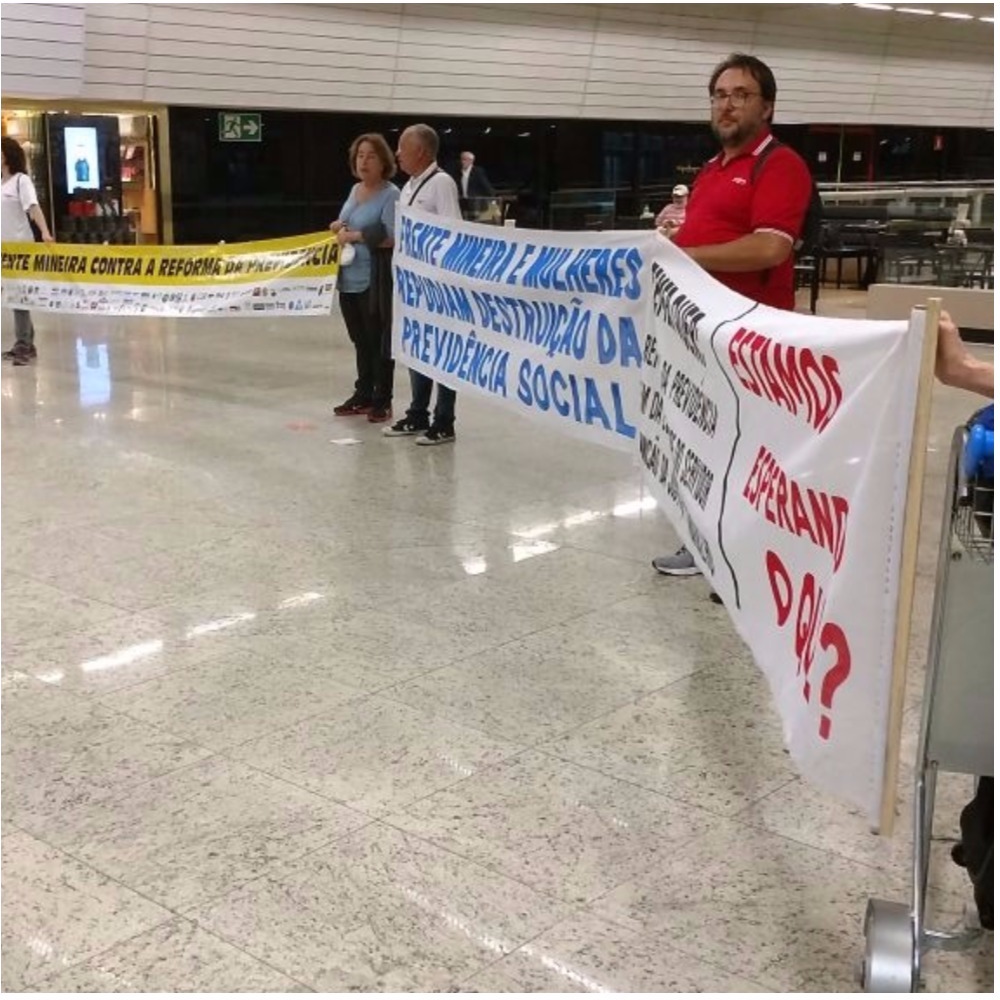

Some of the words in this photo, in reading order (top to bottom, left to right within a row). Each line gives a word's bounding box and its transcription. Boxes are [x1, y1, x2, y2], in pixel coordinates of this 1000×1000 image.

[34, 254, 87, 273] MINEIRA
[90, 257, 142, 276] CONTRA
[145, 258, 156, 276] A
[159, 256, 223, 277] REFORMA
[399, 215, 450, 265] FRENTE
[441, 233, 514, 284] MINEIRA
[506, 245, 536, 284] E
[523, 247, 643, 300] MULHERES
[395, 265, 477, 324] REPUDIAM
[472, 290, 591, 358] DESTRUIÇÃO
[597, 313, 642, 368] DA
[401, 317, 510, 398] PREVIDÊNCIA
[518, 358, 636, 439] SOCIAL
[728, 327, 844, 434] ESTAMOS
